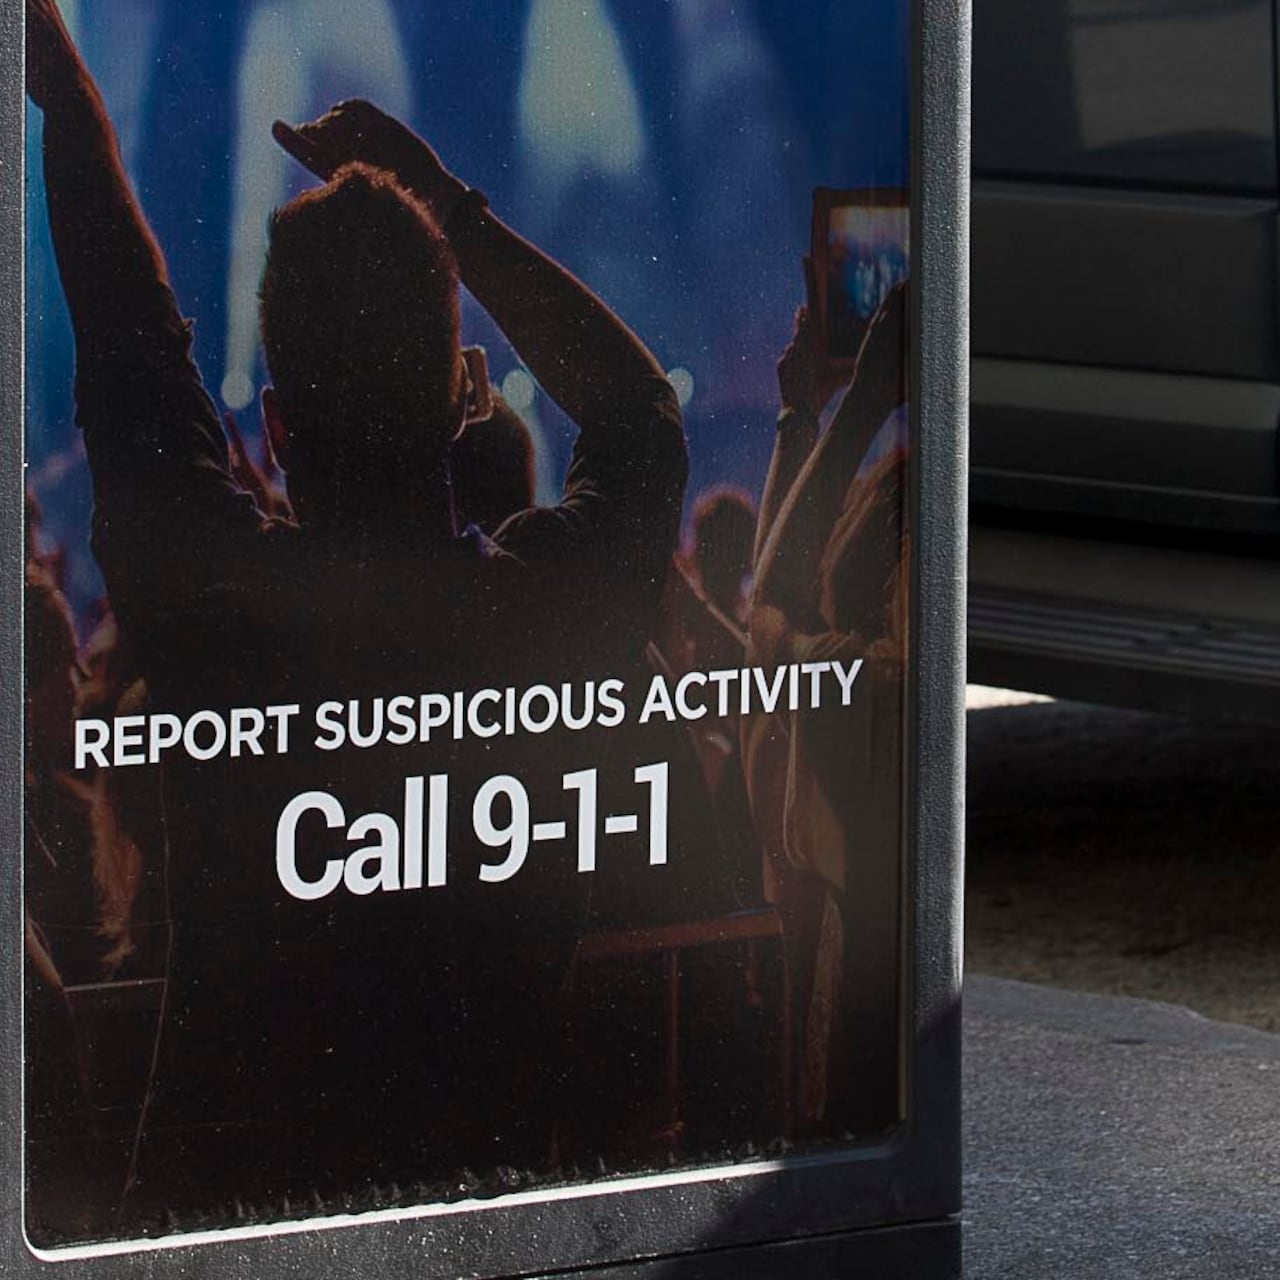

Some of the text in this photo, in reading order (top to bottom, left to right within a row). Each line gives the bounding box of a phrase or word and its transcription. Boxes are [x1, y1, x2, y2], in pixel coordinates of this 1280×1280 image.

[73, 658, 864, 771] REPORT SUSPICIOUS ACTIVITY
[275, 761, 669, 902] Call 9-1-1
